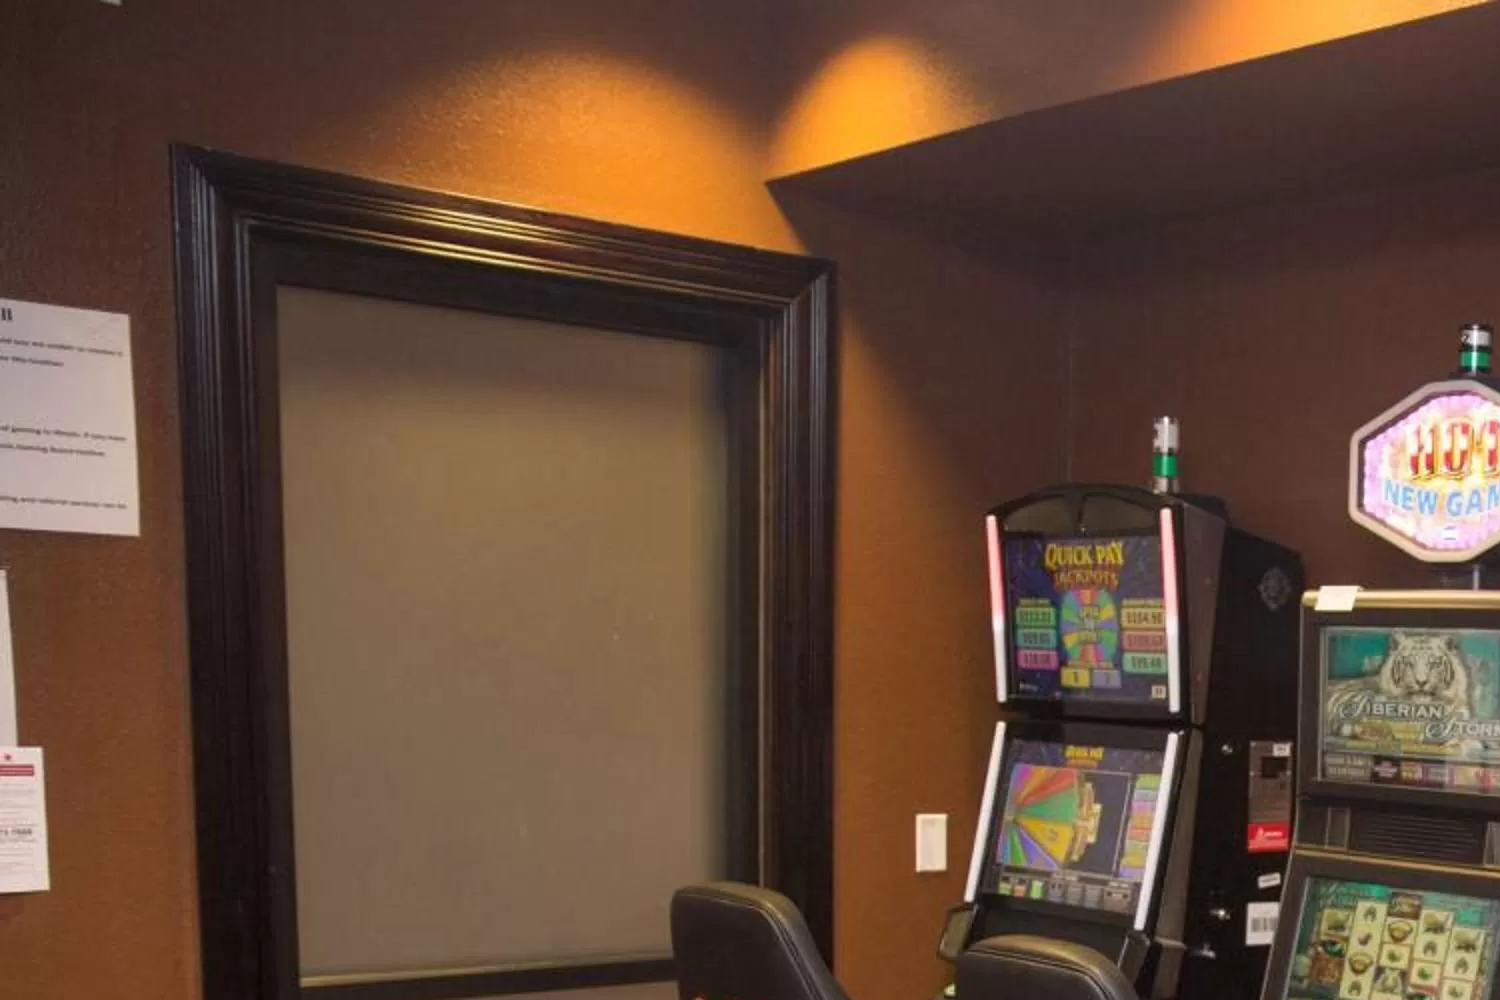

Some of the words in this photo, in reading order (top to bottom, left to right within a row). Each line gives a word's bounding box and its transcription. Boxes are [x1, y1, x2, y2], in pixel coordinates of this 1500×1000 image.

[1384, 477, 1439, 516] NEW
[1044, 543, 1093, 571] QUICK
[1095, 540, 1125, 567] PAY
[1055, 569, 1119, 589] JACKPOTS
[1338, 696, 1443, 721] SIBERIAN
